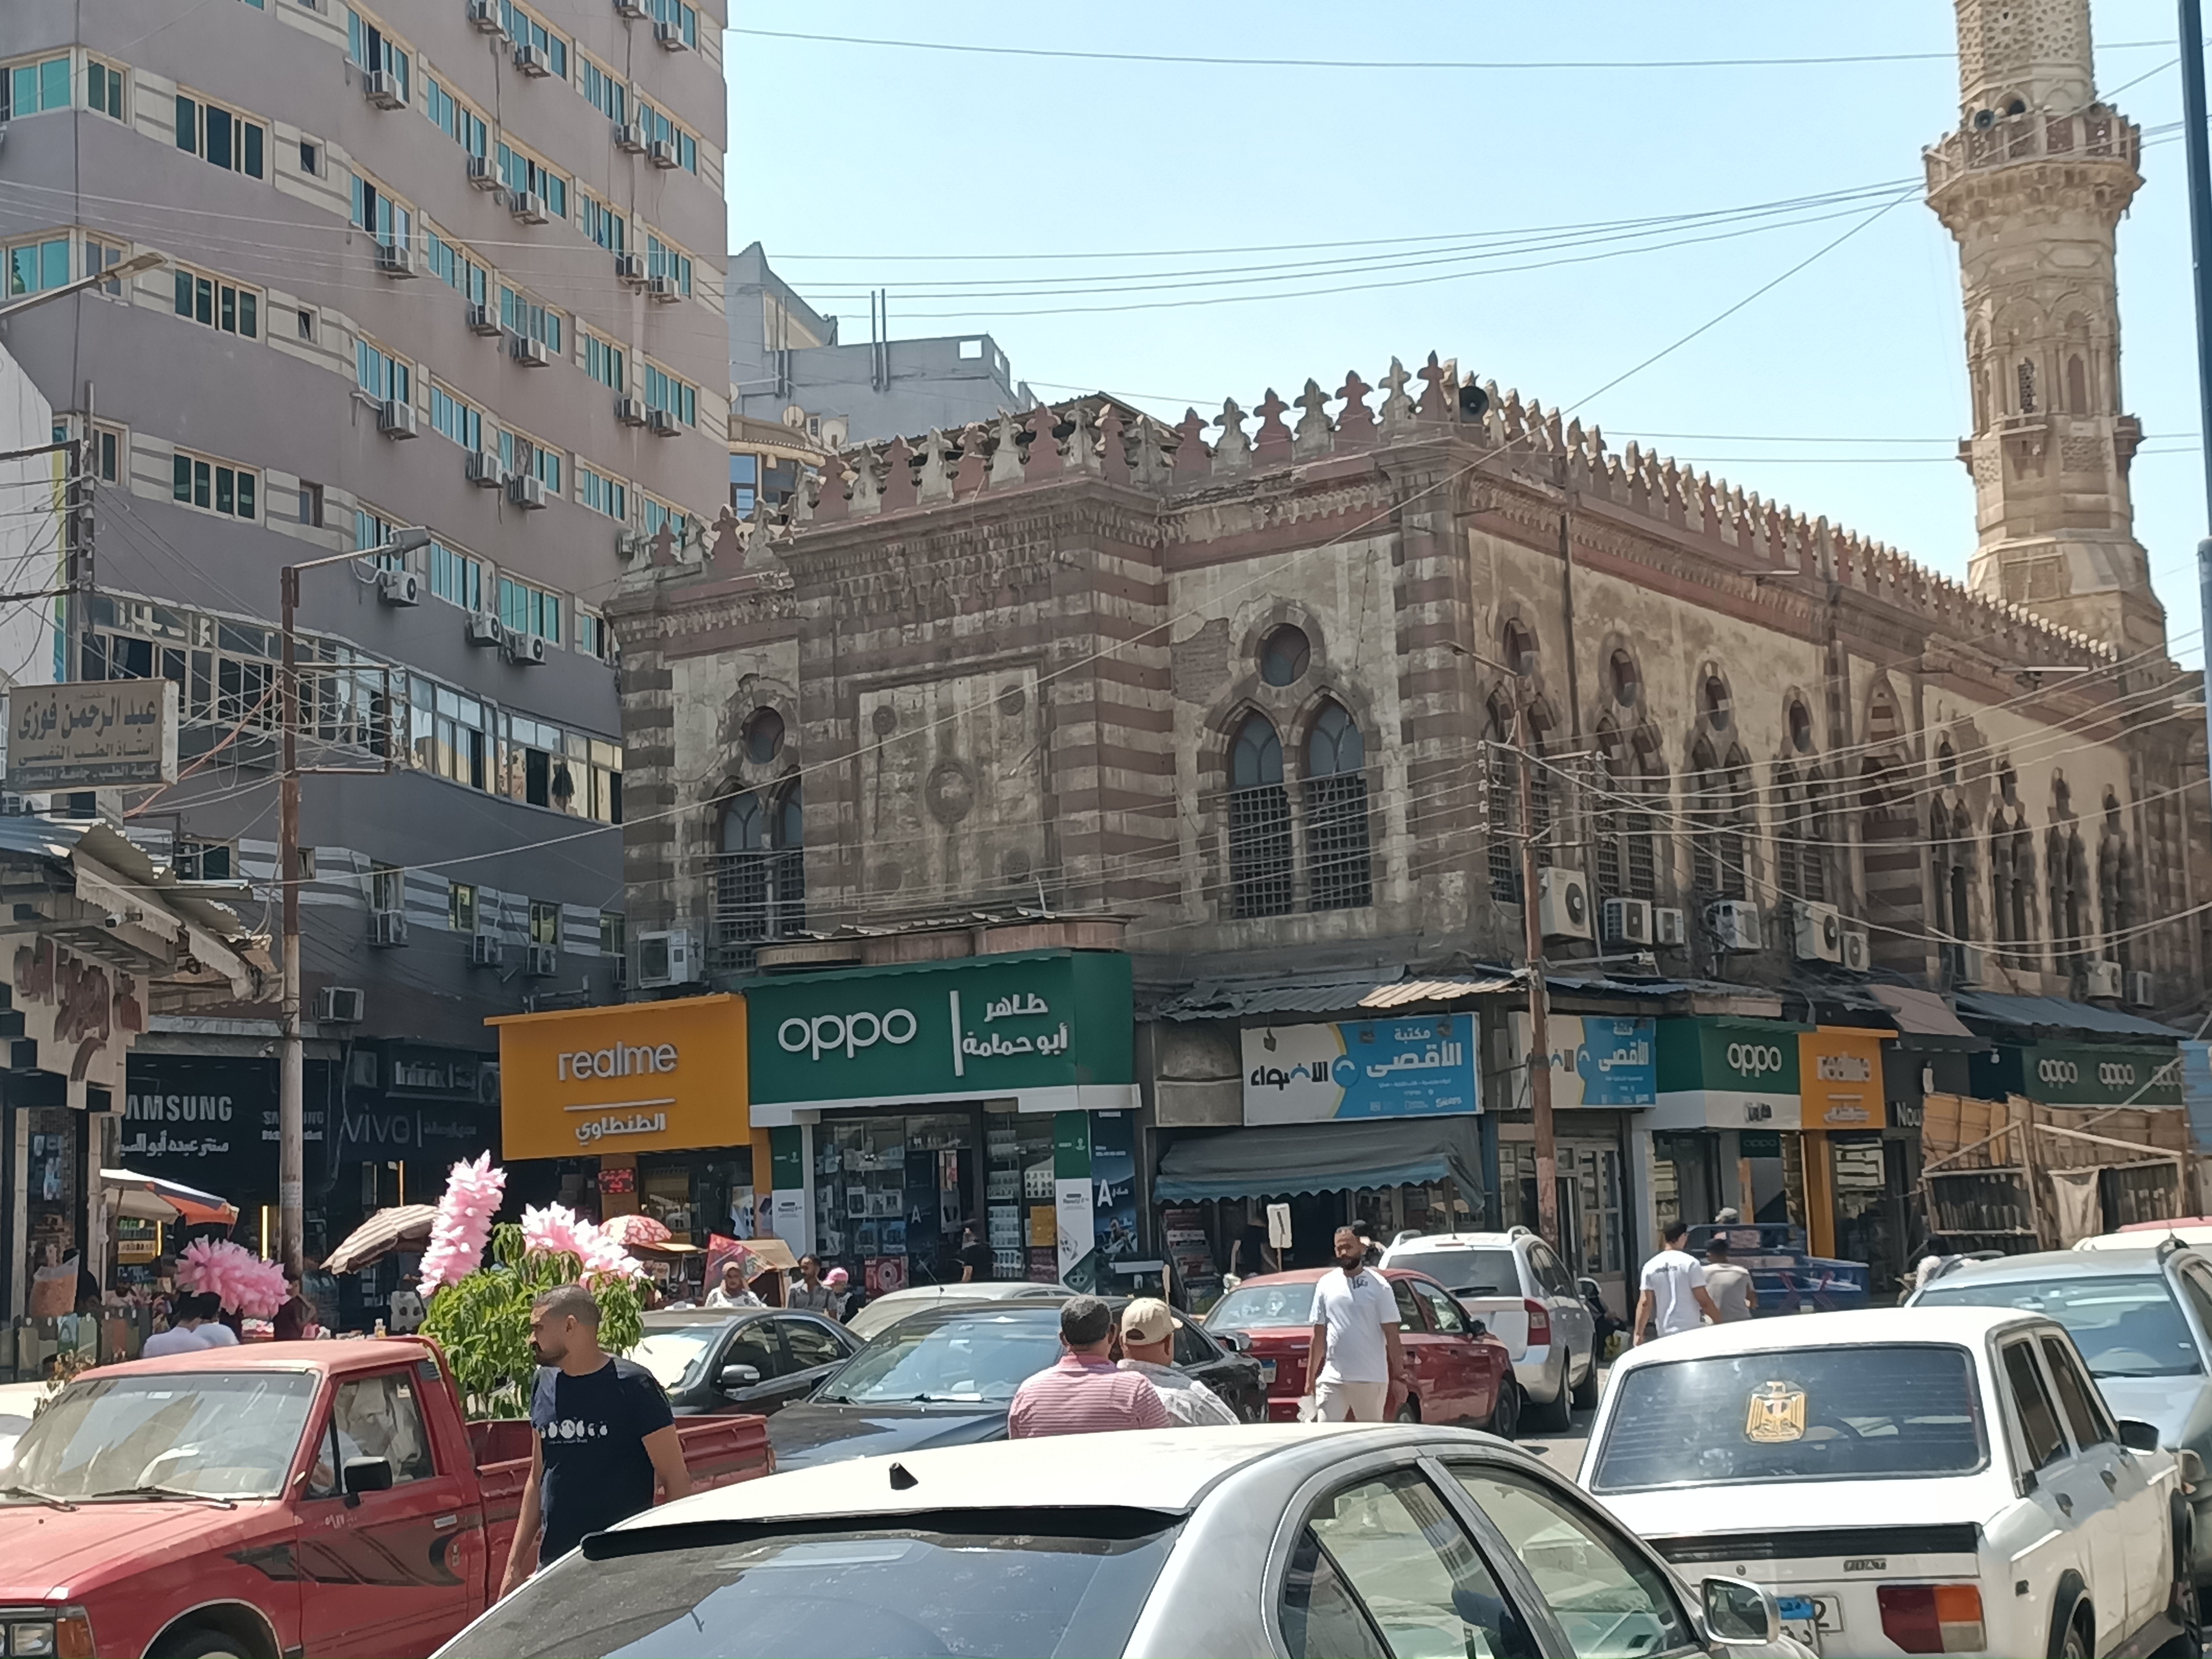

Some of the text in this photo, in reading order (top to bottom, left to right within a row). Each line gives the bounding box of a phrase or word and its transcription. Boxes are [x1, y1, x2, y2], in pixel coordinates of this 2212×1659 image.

[61, 695, 121, 739] الرحمن
[124, 697, 156, 734] عبد
[75, 743, 113, 763] الطب
[60, 766, 90, 782] جامعة
[98, 765, 128, 781] الطب
[131, 763, 156, 779] كلية
[983, 993, 1048, 1022] طاهر
[778, 1008, 916, 1060] oppo
[962, 1022, 1068, 1056] أبو حمامة
[1394, 1027, 1431, 1044] مكتبة
[559, 1041, 678, 1081] realme
[1366, 1040, 1462, 1077] الأقصى
[1728, 1043, 1782, 1077] oppo
[126, 1094, 232, 1121] AMSUNG
[147, 1129, 167, 1157] أبو
[576, 1113, 666, 1145] الطنطاوي
